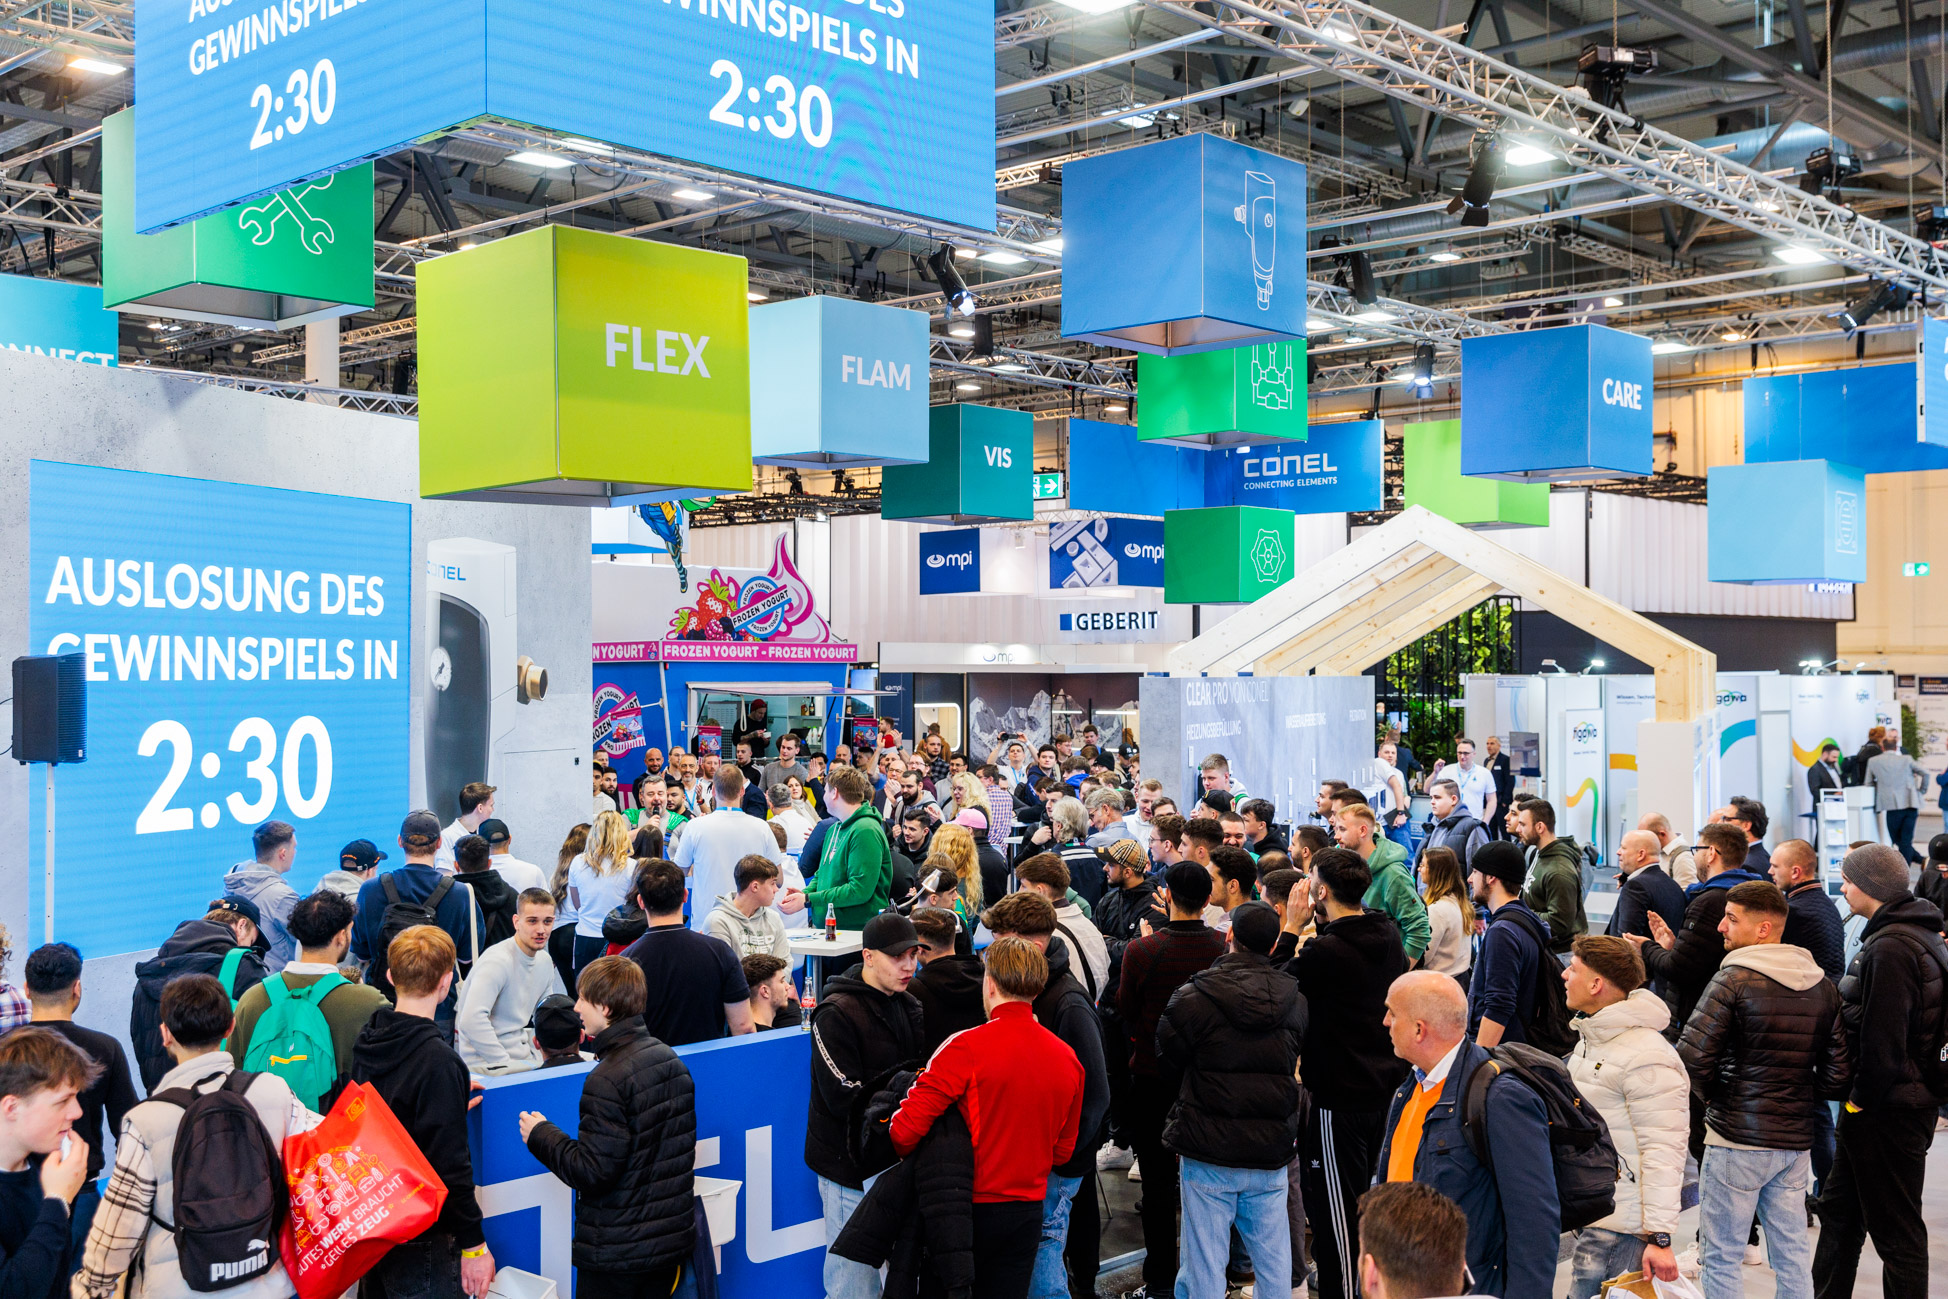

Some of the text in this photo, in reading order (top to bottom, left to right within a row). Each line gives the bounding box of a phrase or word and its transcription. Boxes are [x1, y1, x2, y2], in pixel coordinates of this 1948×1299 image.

[886, 35, 918, 79] IN
[250, 58, 337, 150] 2:30
[709, 59, 833, 148] 2:30
[605, 322, 712, 379] FLEX
[842, 354, 911, 391] FLAM
[1602, 377, 1642, 411] CARE
[984, 445, 1012, 468] VIS
[1244, 453, 1338, 477] CONEL
[1244, 476, 1338, 490] CONNECTING ELEMENTS
[946, 550, 972, 571] mpi
[1142, 544, 1164, 565] mpi
[45, 555, 385, 617] AUSLOSUNG DES
[733, 589, 789, 626] FROZEN YOGURT
[1076, 610, 1158, 631] GEBERIT
[363, 639, 398, 680] IN
[600, 643, 645, 659] YOGURT
[664, 644, 711, 657] FROZEN
[713, 645, 759, 658] YOGURT
[768, 646, 811, 658] FROZEN
[813, 647, 855, 659] YOGURT
[1186, 681, 1212, 706] CLEAR
[1212, 681, 1229, 705] PRO
[135, 715, 333, 834] 2:30
[320, 1215, 354, 1249] WERK
[352, 1173, 404, 1221] BRAUCHT
[323, 1205, 390, 1267] GEILES ZEUG
[211, 1249, 269, 1282] PUMA
